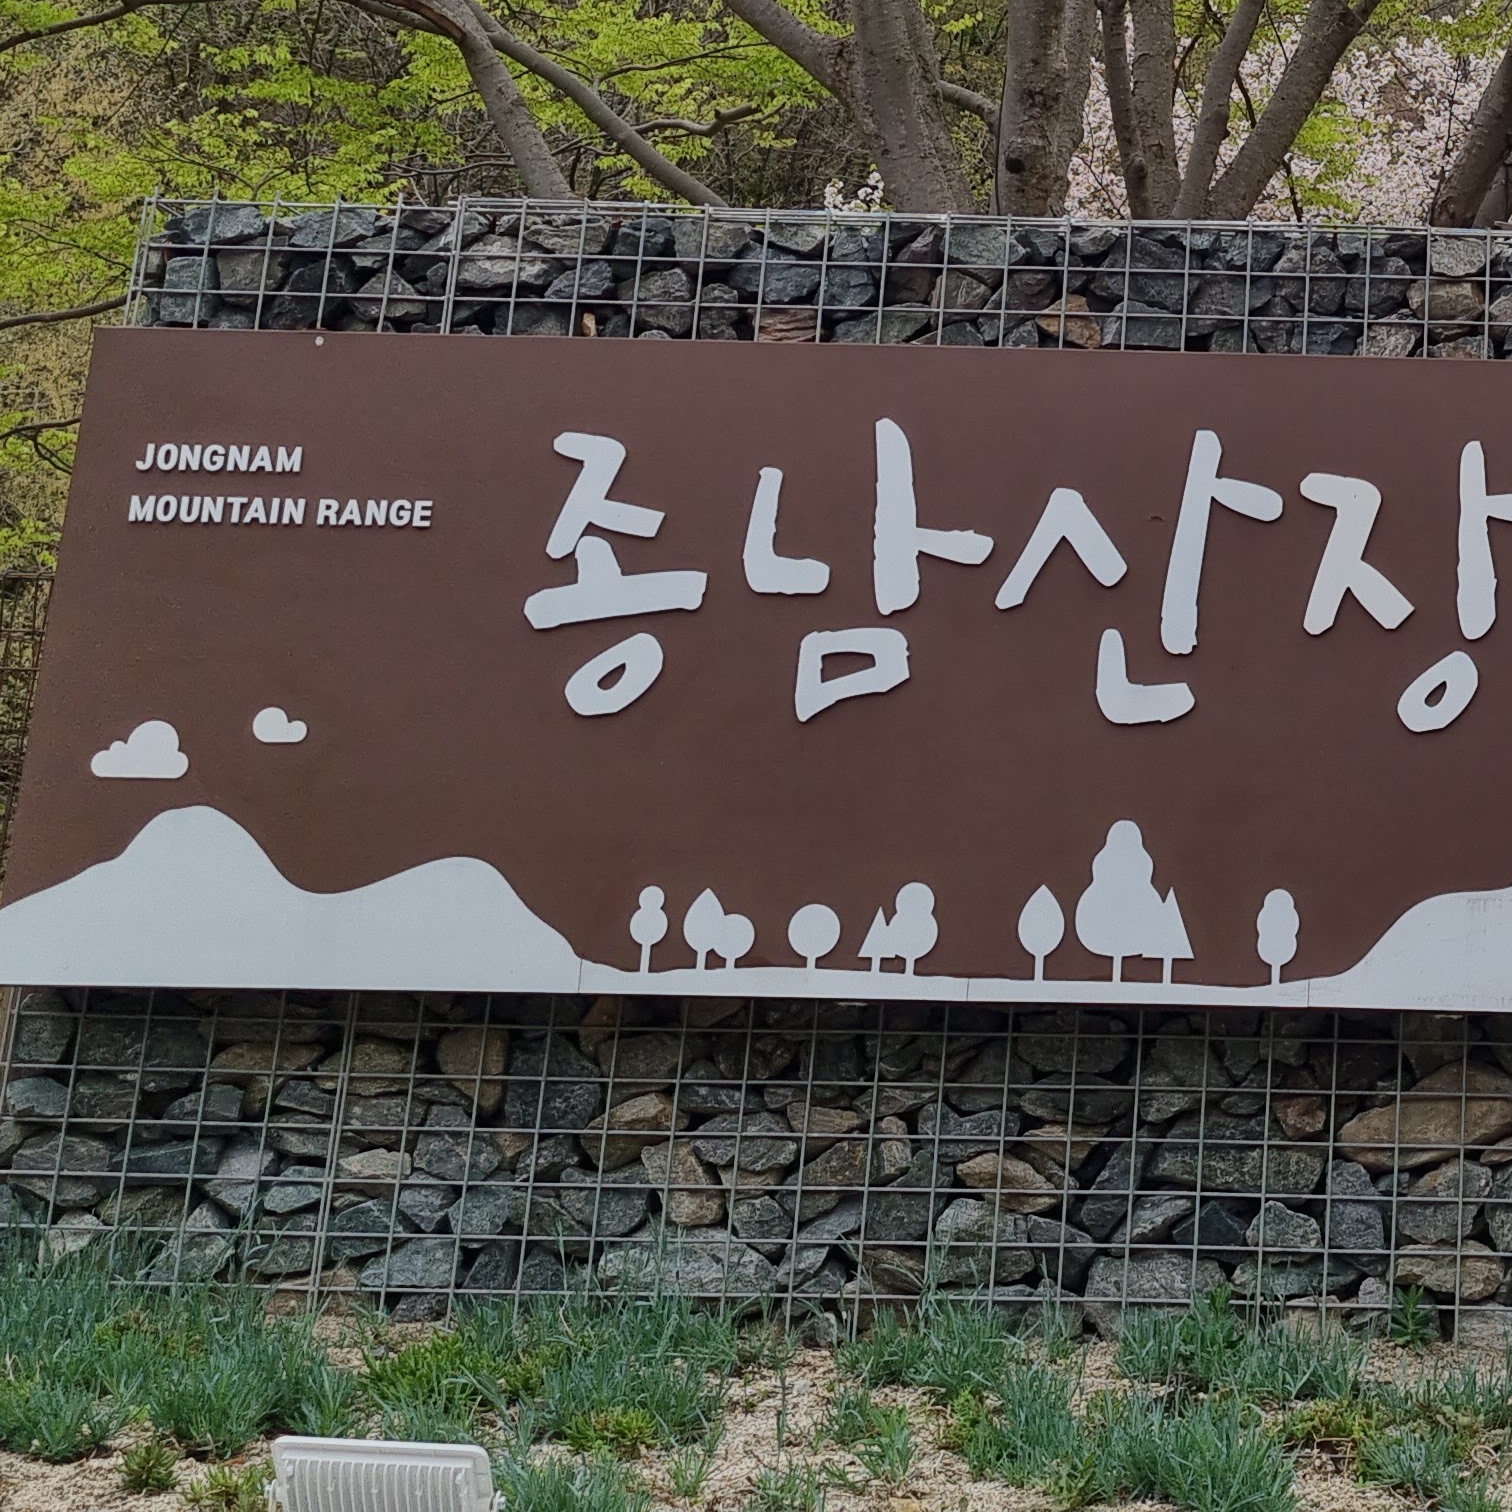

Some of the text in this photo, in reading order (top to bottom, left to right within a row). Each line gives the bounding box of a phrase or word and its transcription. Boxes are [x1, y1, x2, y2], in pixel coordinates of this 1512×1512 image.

[135, 443, 303, 472] JONGNAM
[128, 495, 434, 527] MOUNTAIN RANGE
